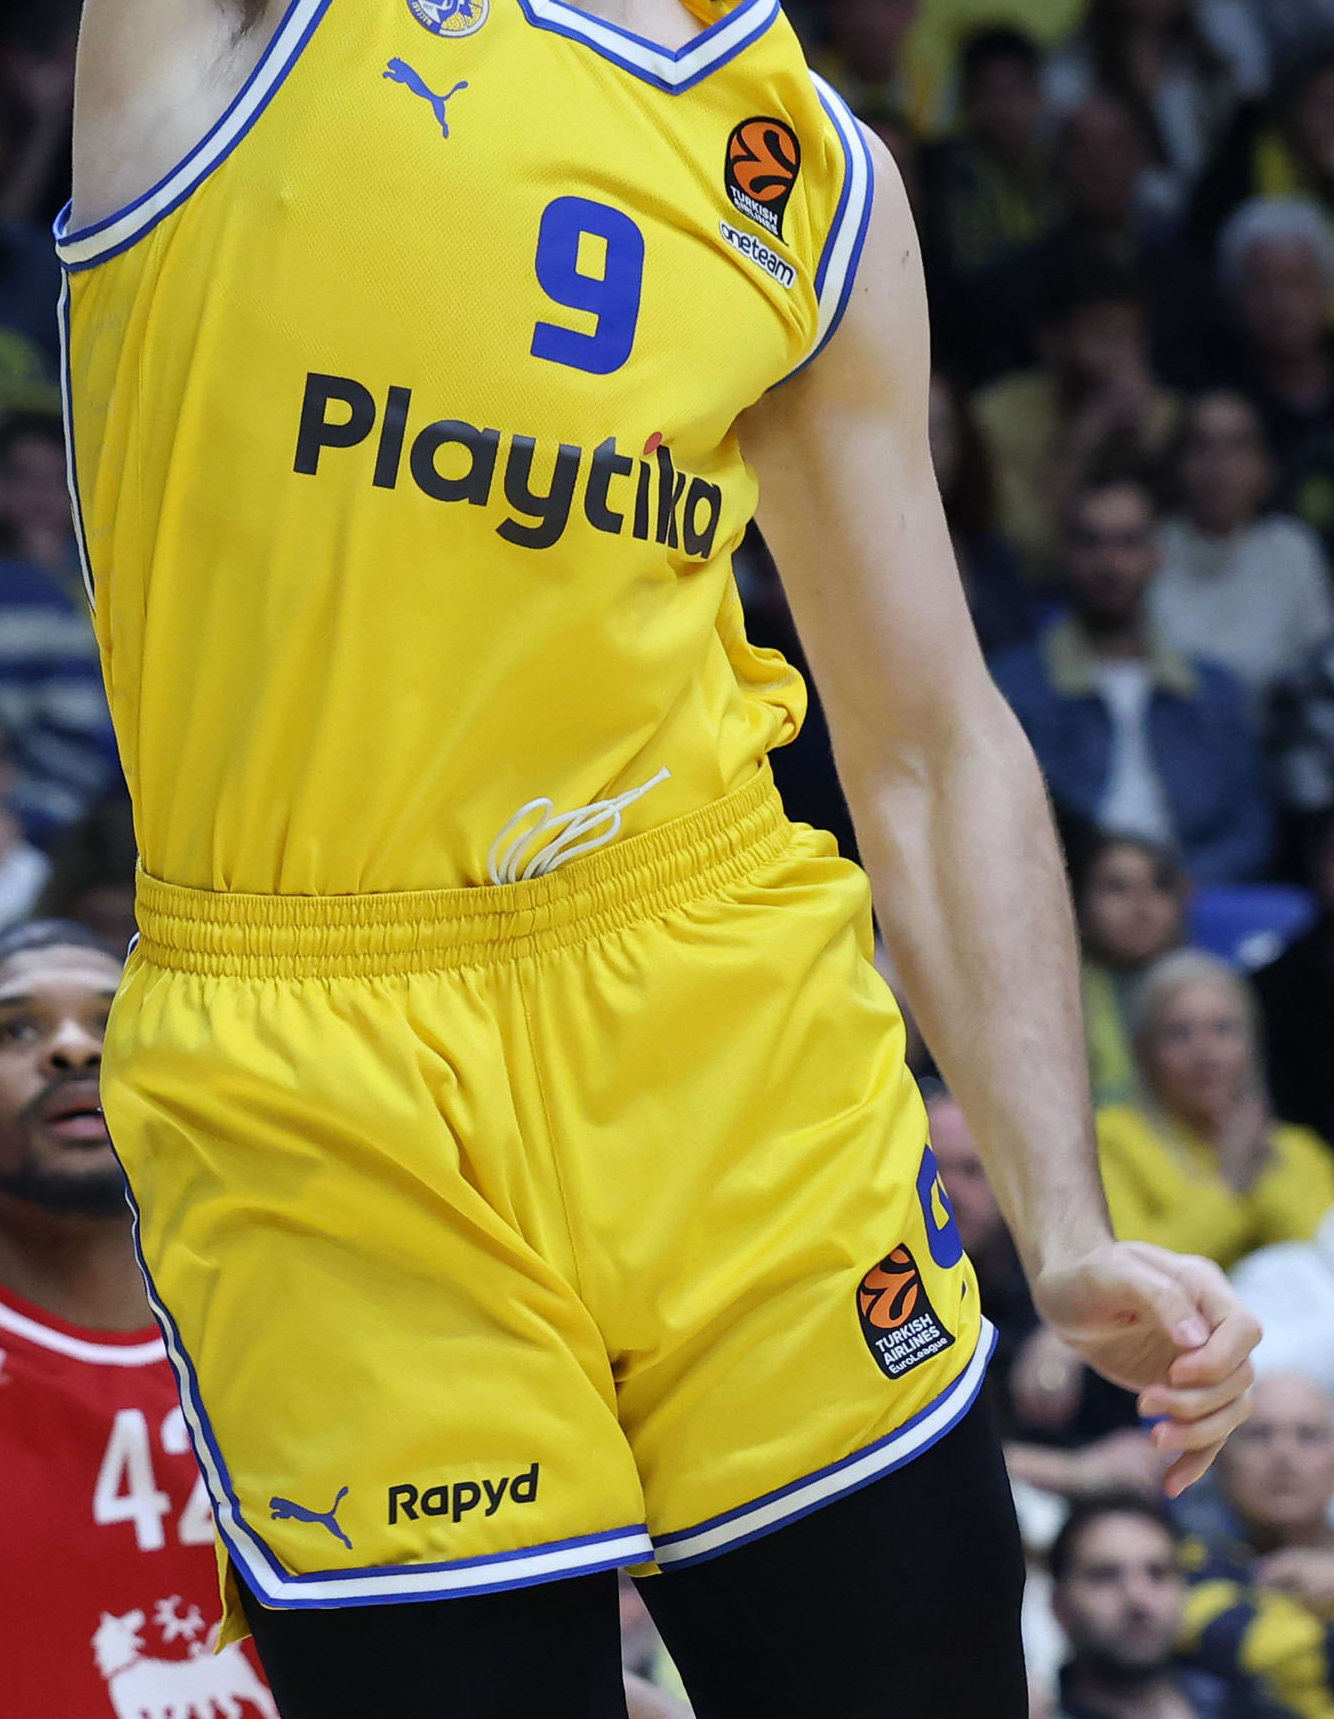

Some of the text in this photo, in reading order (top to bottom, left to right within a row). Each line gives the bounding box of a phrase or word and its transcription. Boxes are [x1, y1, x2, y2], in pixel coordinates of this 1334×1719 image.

[730, 185, 778, 225] TURKISH
[720, 223, 795, 286] oneteam
[530, 195, 645, 375] 9
[293, 371, 723, 560] Playtika
[875, 1313, 934, 1352] TURKISH
[883, 1325, 941, 1366] AIRLINES
[888, 1337, 948, 1374] EuroLeague
[388, 1462, 540, 1525] Rapyd
